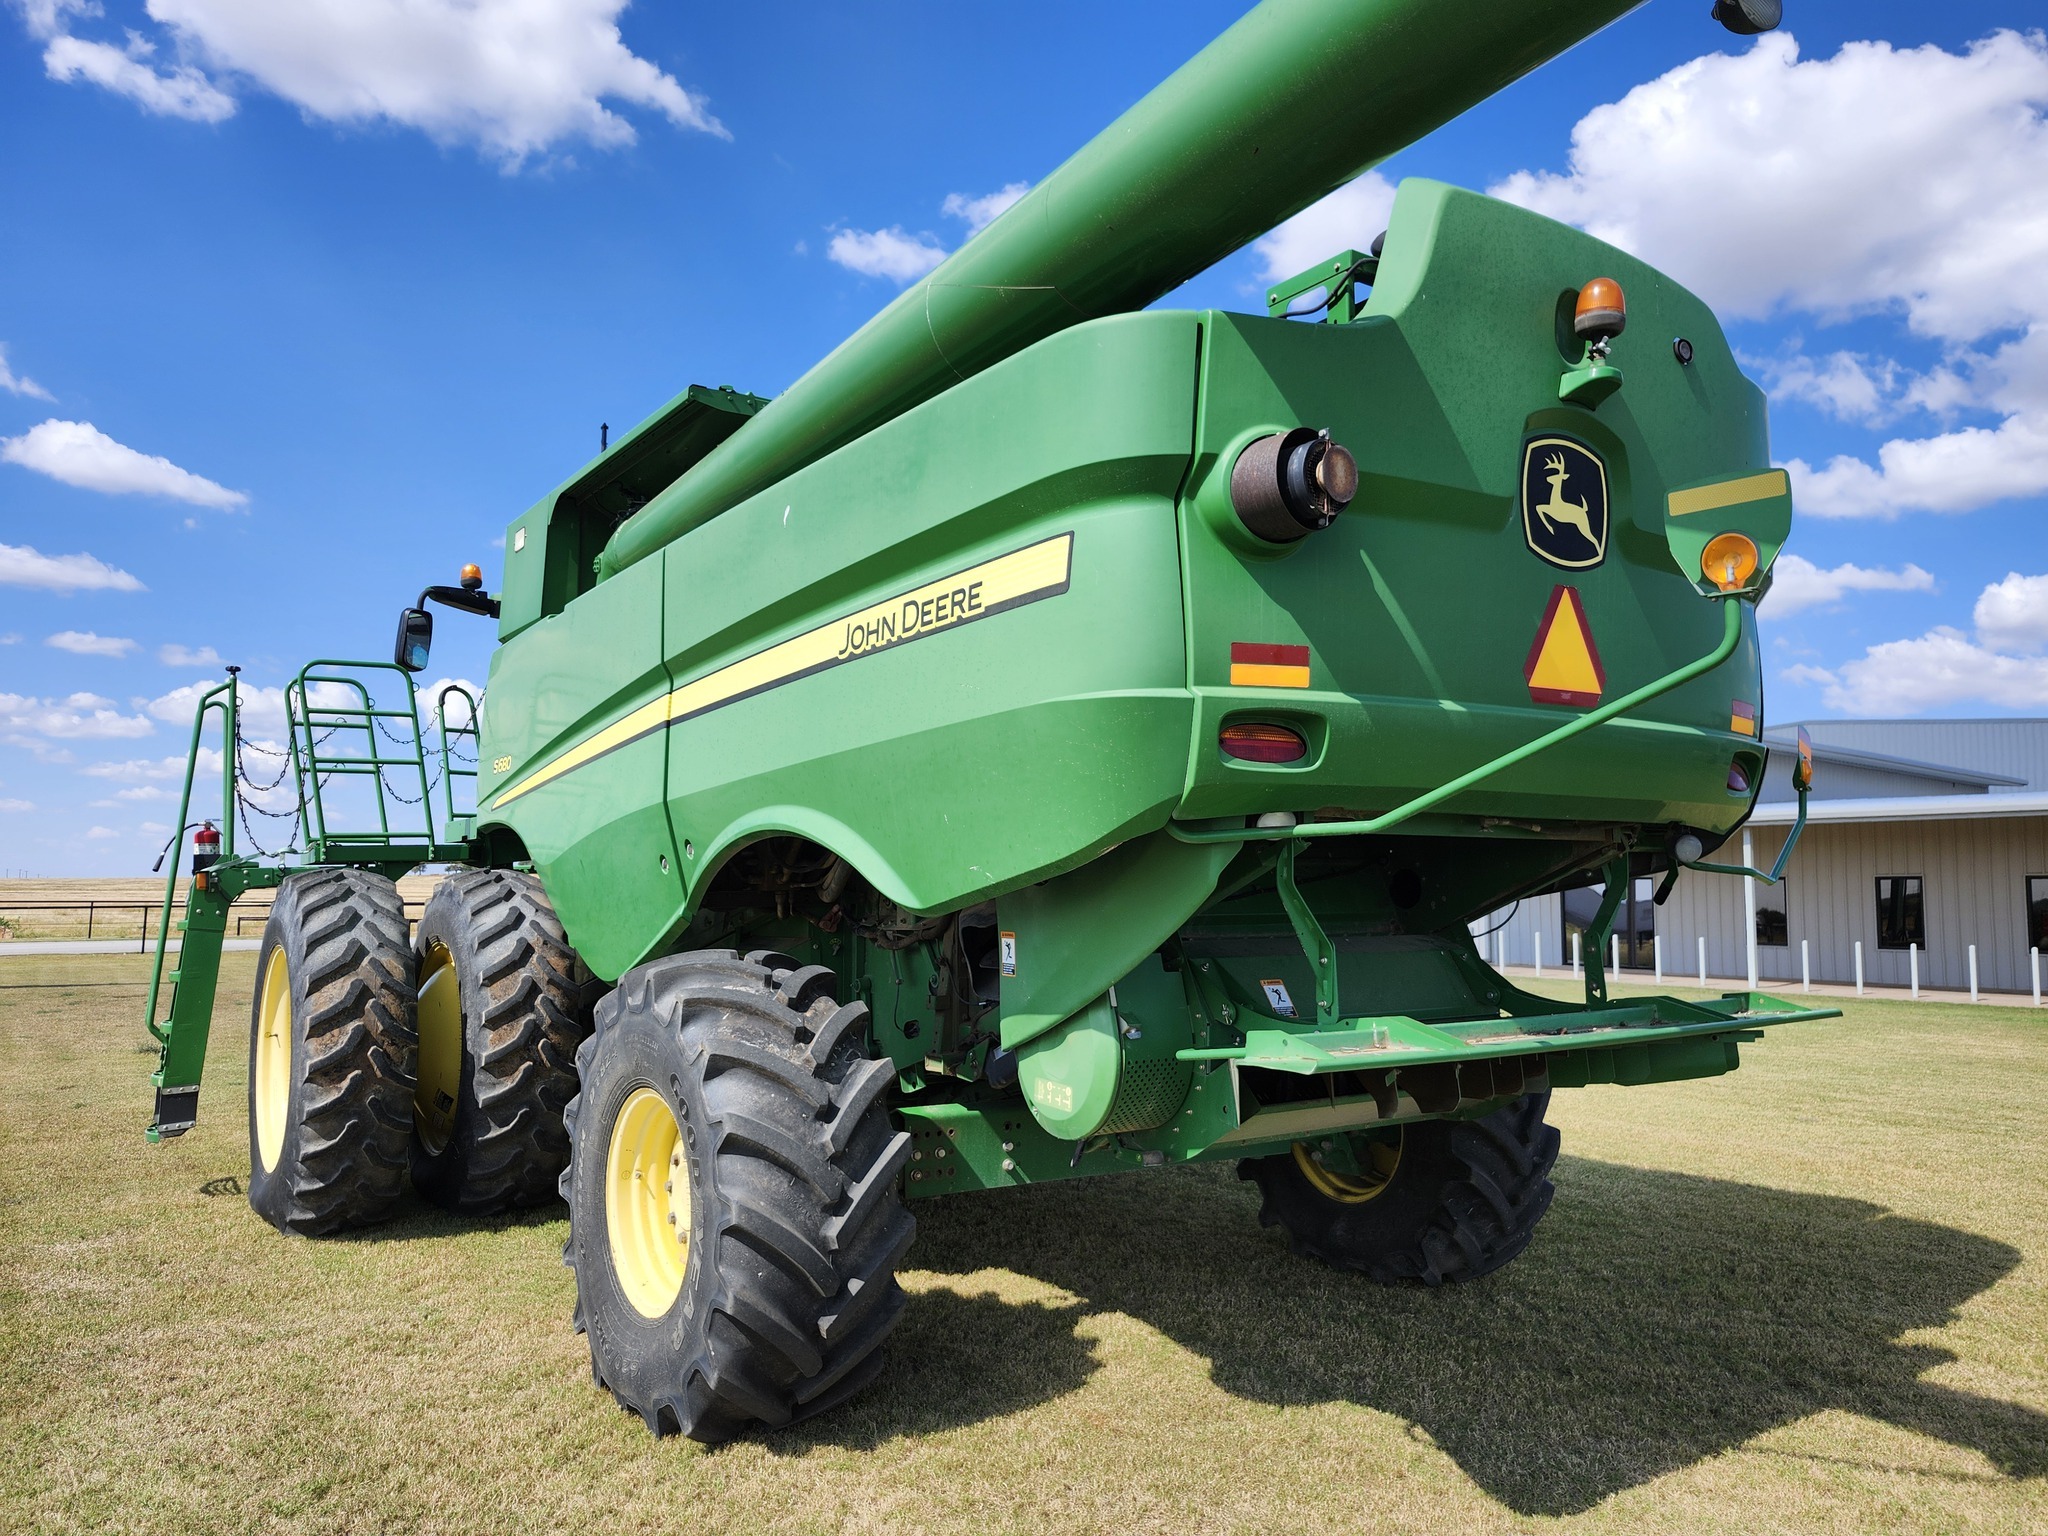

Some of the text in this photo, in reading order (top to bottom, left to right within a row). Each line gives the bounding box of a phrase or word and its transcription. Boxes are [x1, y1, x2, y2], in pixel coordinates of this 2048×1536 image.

[838, 582, 983, 654] JOHN DEERE
[493, 755, 512, 774] S680
